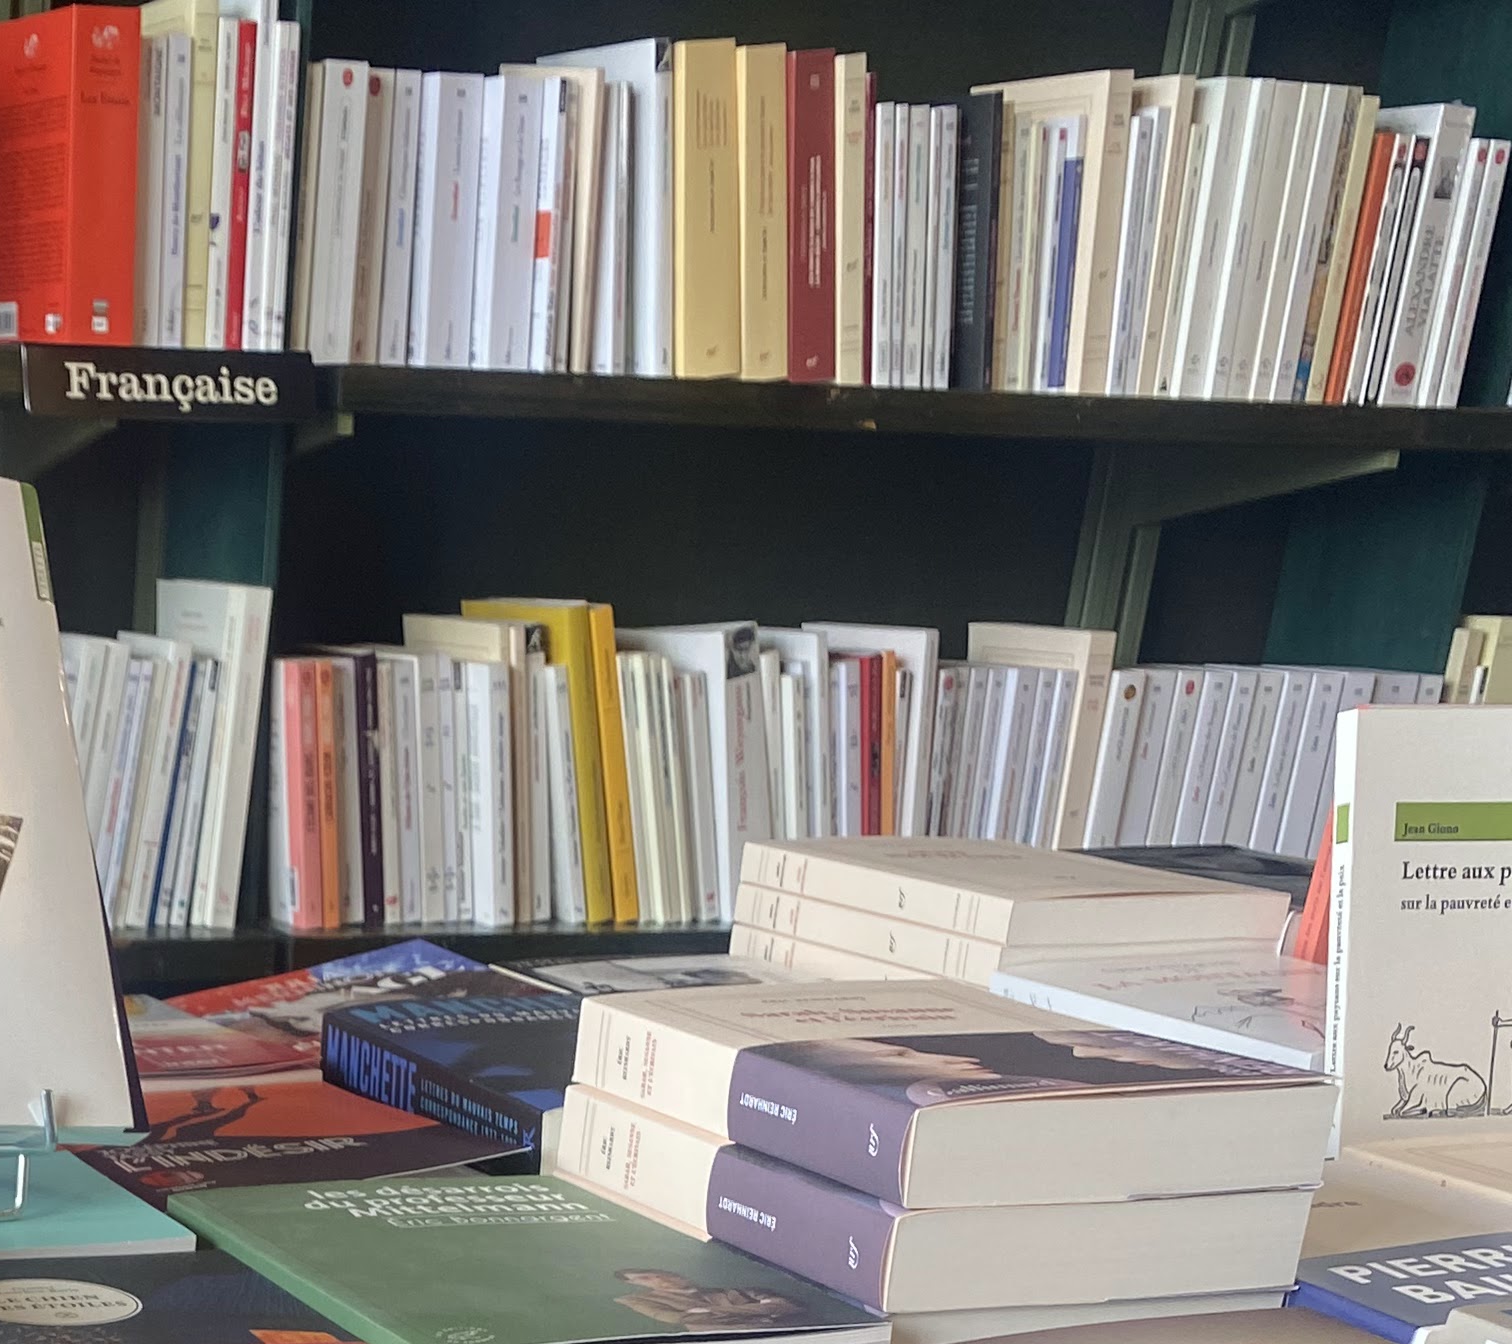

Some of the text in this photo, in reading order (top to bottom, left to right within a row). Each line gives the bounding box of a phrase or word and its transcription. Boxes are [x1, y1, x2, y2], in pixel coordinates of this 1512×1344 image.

[66, 361, 278, 411] Française
[1402, 822, 1459, 837] Jean Giono
[1401, 861, 1458, 880] Lettre
[1461, 865, 1496, 880] aux
[1400, 893, 1502, 915] sur la pauvreté
[326, 1022, 418, 1114] MANCHETTE
[739, 1091, 798, 1126] ÉRIC REINHARDT
[307, 1181, 552, 1201] les désarrois
[303, 1192, 566, 1213] du professeur
[348, 1200, 589, 1220] Mittelmann
[718, 1195, 777, 1233] ÉRIC REINHARDT
[1326, 1244, 1512, 1285] PIERR
